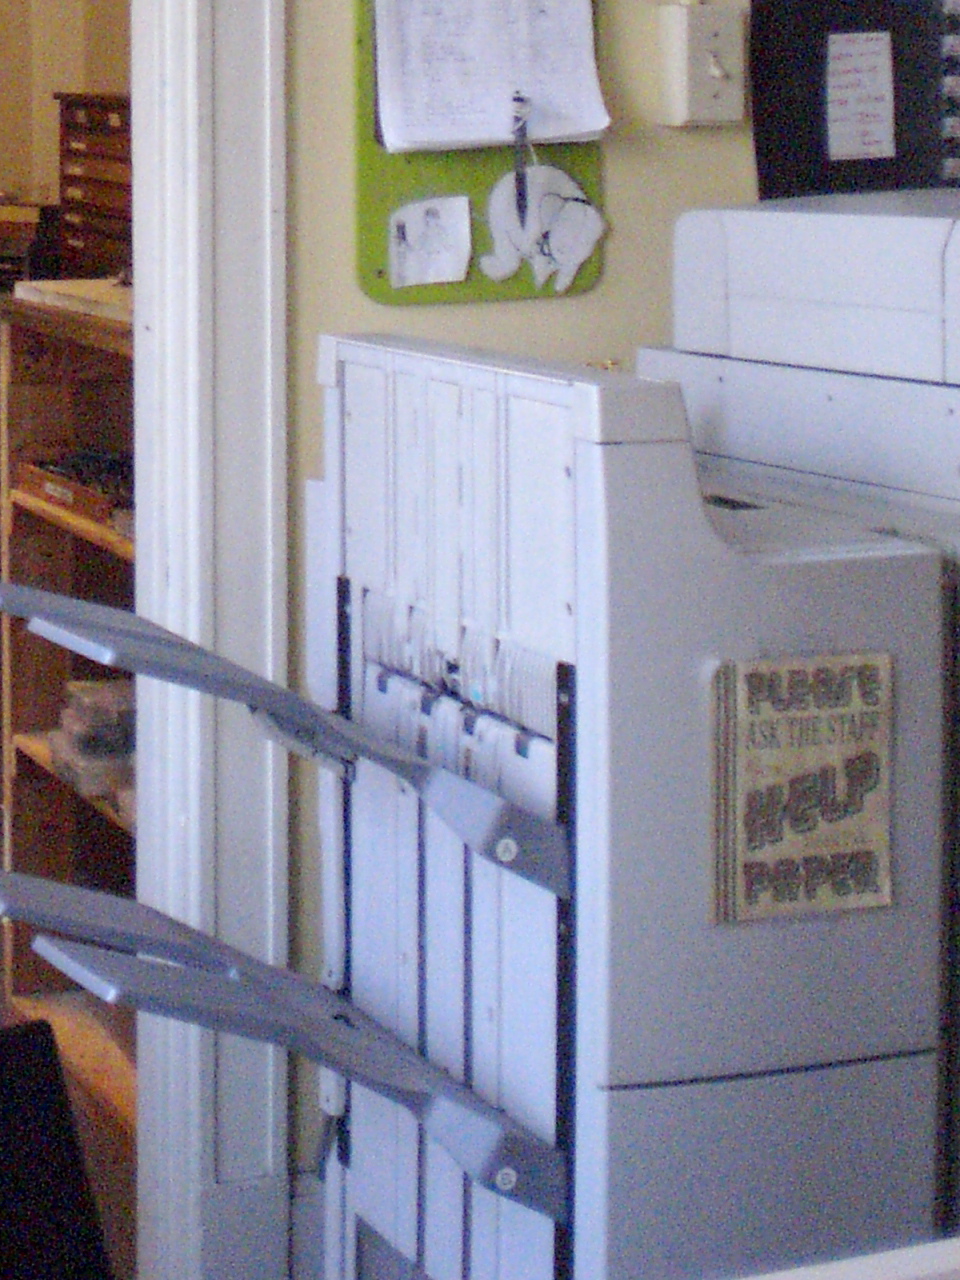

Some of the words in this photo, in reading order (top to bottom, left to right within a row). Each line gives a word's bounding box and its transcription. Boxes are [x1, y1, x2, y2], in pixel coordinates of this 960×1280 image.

[744, 663, 881, 716] PLEASE
[746, 718, 781, 751] ASK
[788, 716, 823, 747] THE
[744, 751, 881, 851] HELP
[743, 849, 881, 906] PAPER
